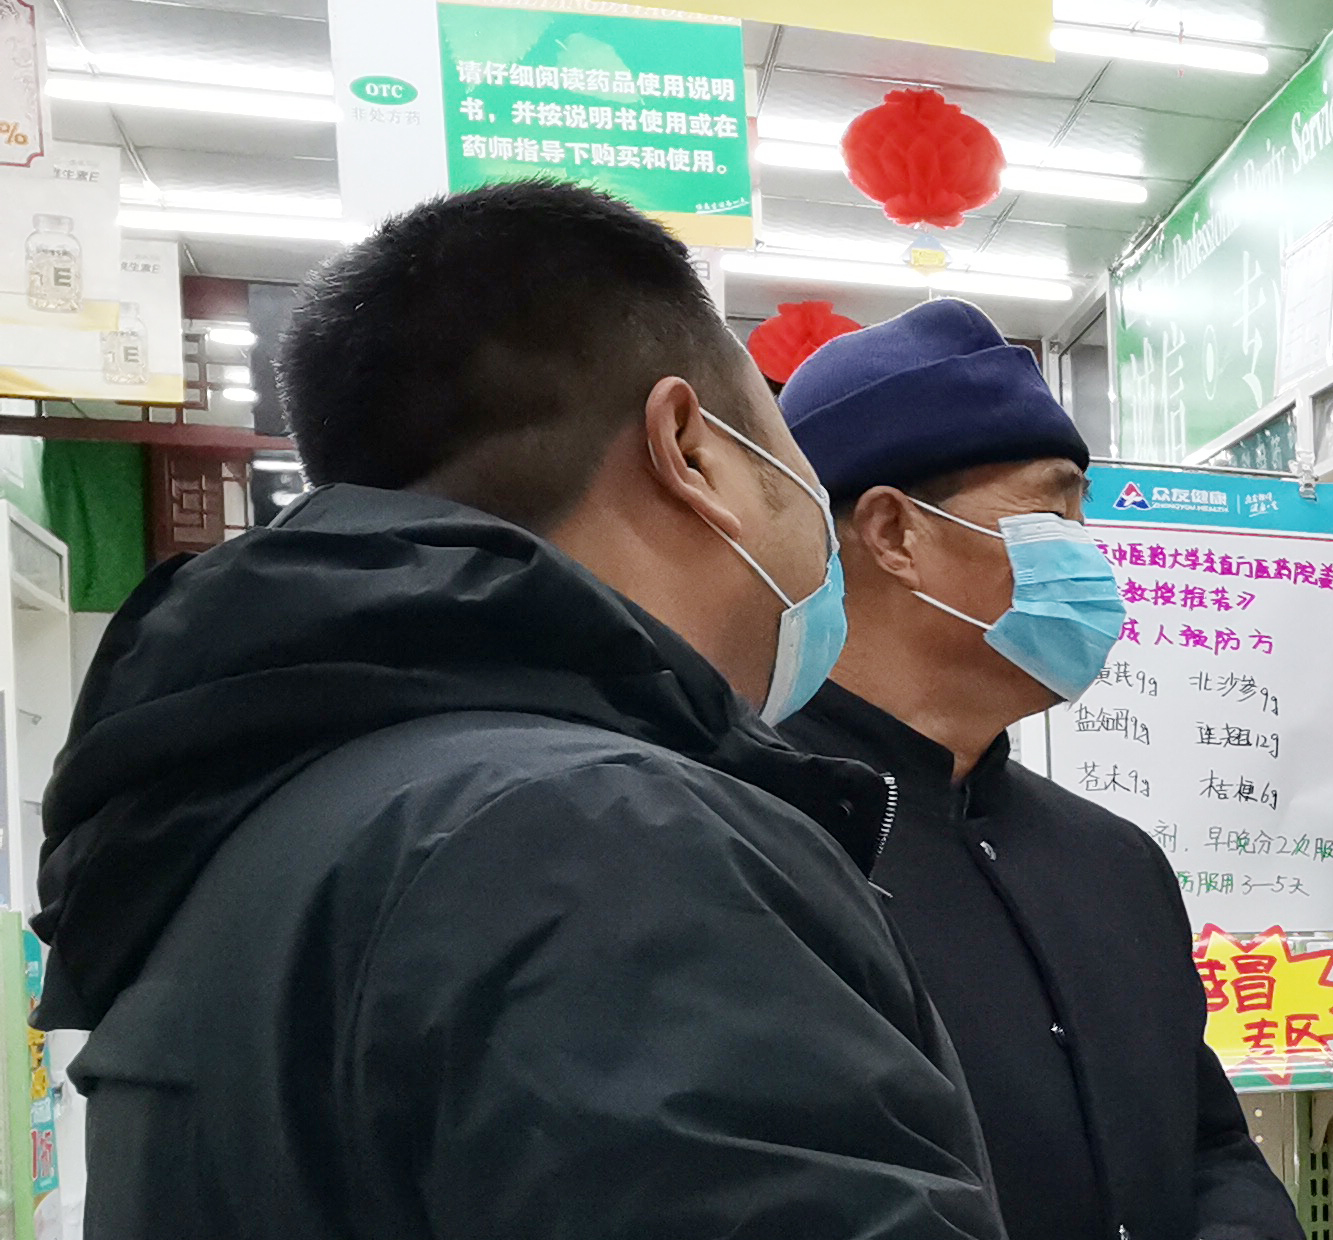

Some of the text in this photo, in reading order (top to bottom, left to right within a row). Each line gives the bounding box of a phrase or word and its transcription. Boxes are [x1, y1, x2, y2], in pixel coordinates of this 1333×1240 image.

[365, 82, 404, 99] OTC
[456, 60, 736, 102] 请仔细阅读药品使用说明
[352, 106, 422, 127] 非处方药
[460, 97, 739, 139] 书，并按说明书使用或在
[461, 134, 728, 175] 药师指导下购买和使用。
[1151, 486, 1227, 506] 众友健康
